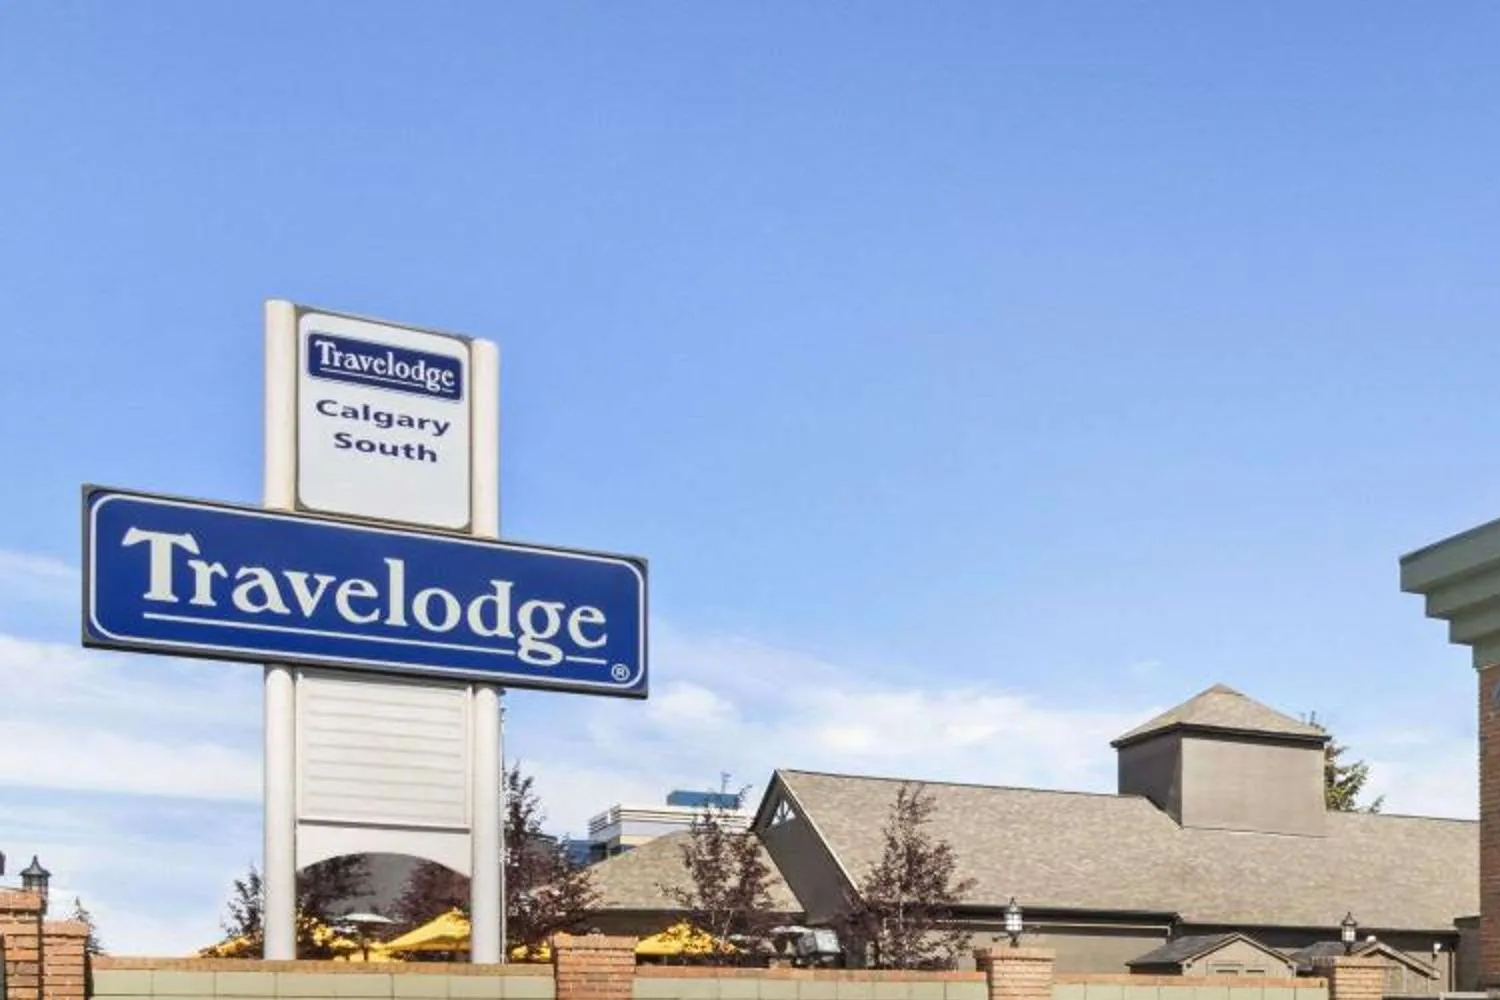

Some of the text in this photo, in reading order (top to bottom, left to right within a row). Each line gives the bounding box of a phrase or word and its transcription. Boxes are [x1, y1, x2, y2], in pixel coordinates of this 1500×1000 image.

[315, 340, 454, 392] Travelodge
[316, 400, 450, 436] Calgary
[334, 432, 437, 462] South
[122, 527, 607, 665] Travelodge
